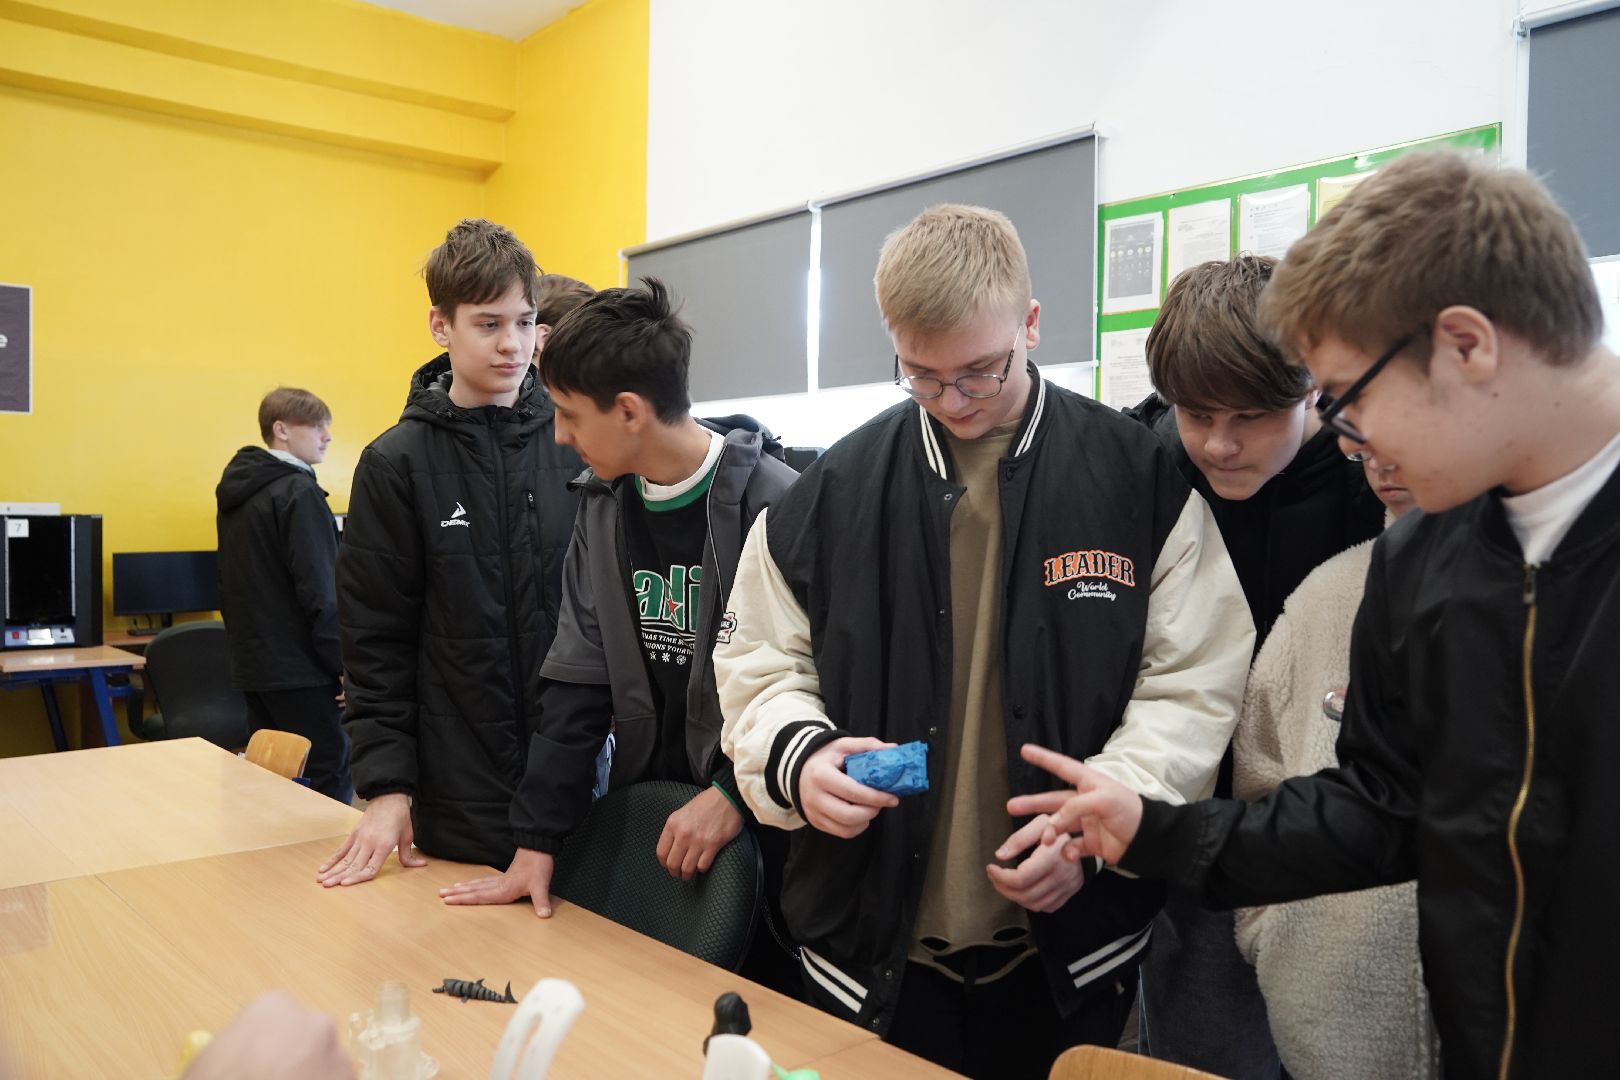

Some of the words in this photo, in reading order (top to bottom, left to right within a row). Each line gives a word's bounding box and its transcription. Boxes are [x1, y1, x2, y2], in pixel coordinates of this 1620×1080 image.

[1044, 550, 1135, 587] LEADER
[1077, 581, 1108, 591] World
[1067, 589, 1116, 601] Community
[659, 635, 678, 644] TIME
